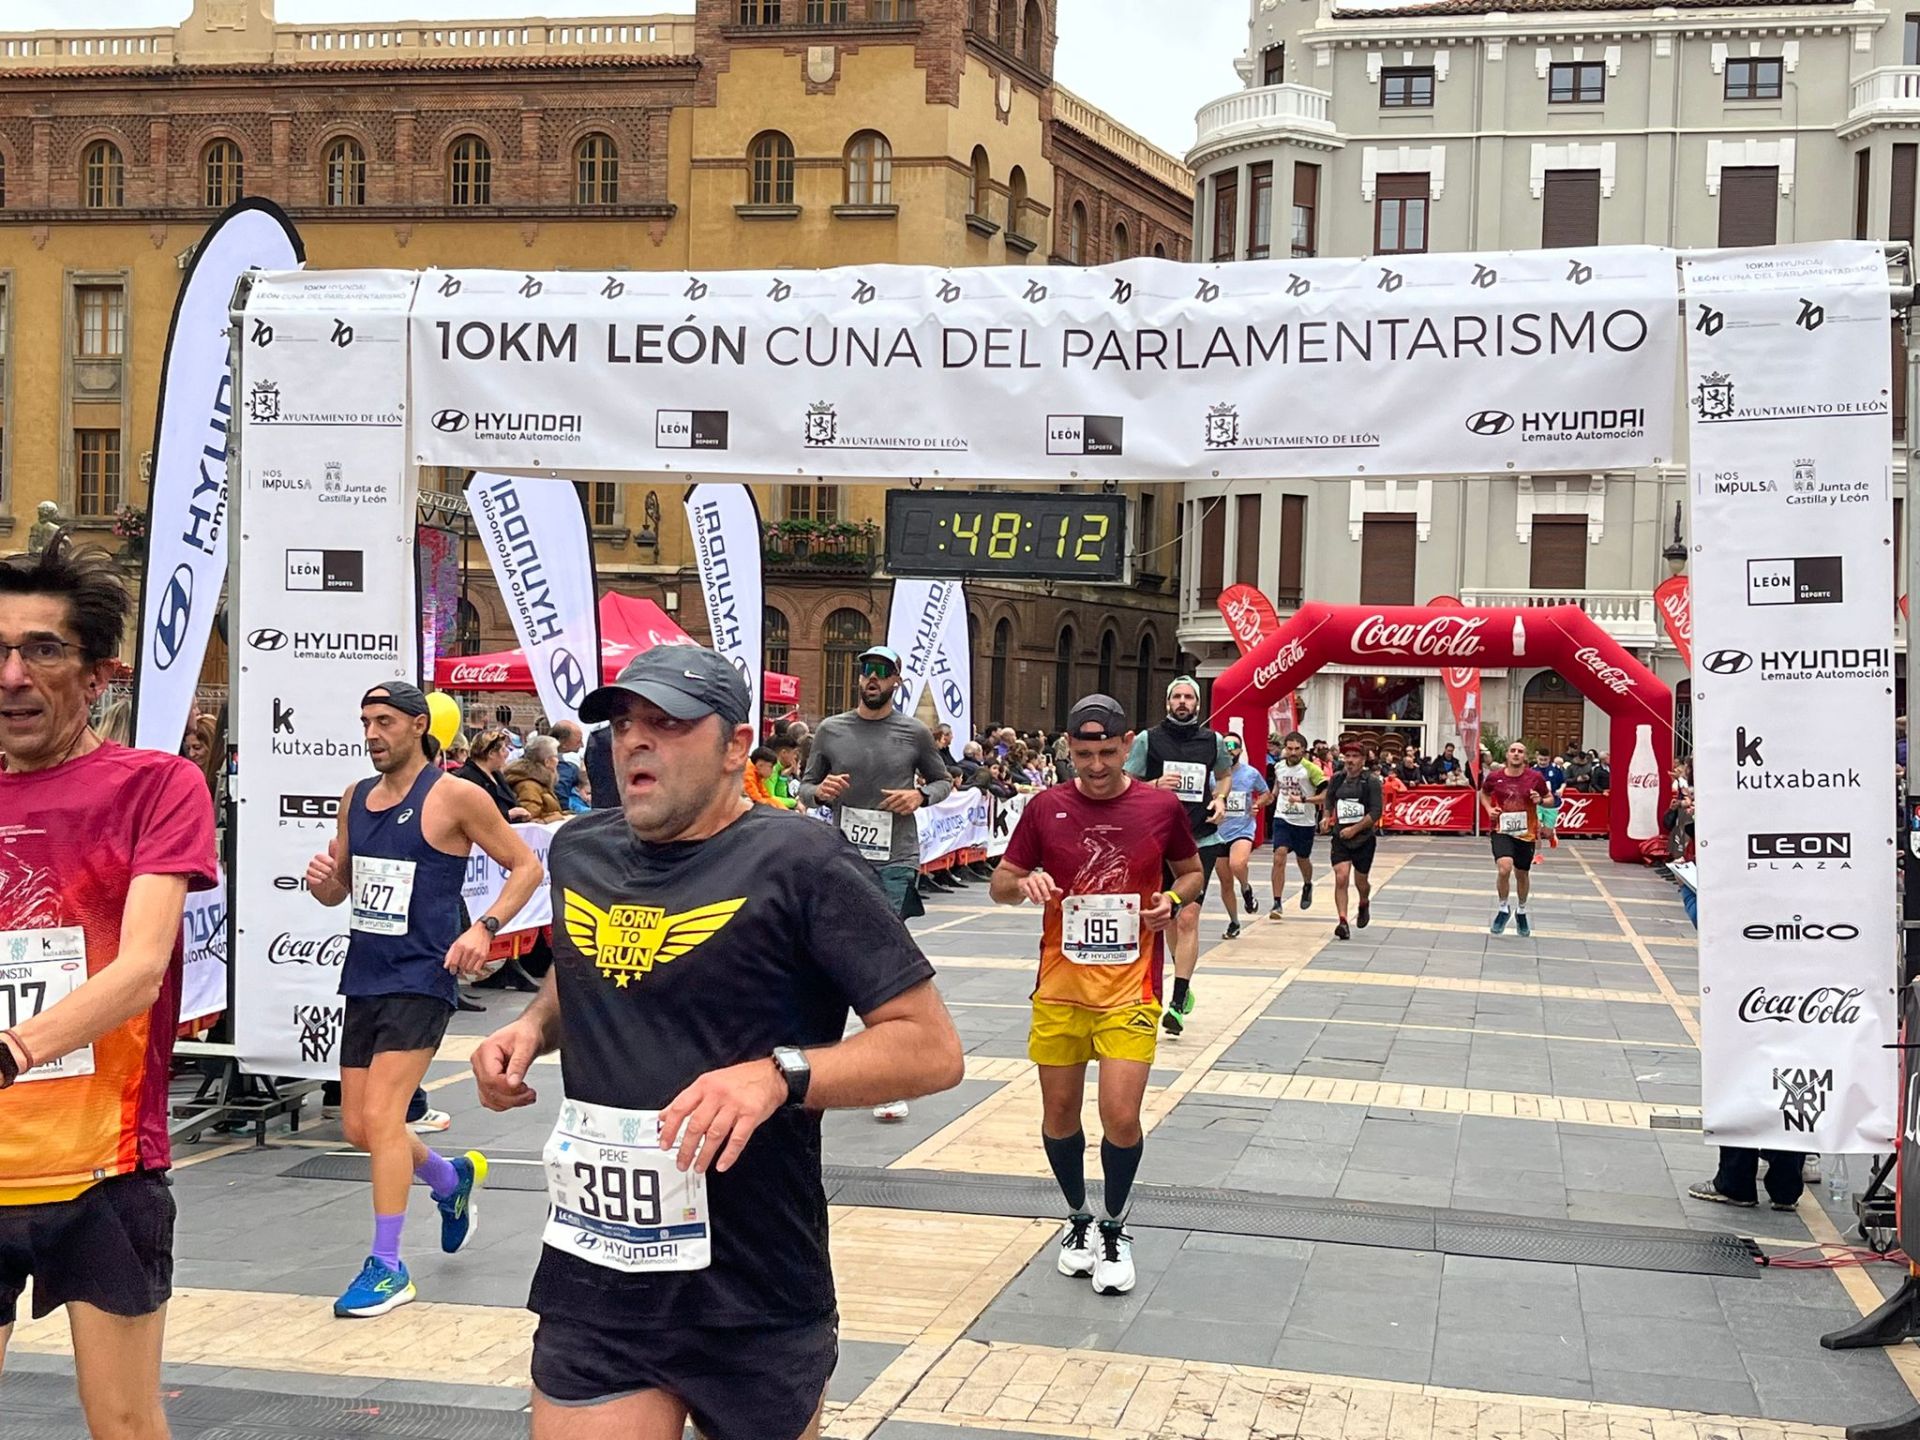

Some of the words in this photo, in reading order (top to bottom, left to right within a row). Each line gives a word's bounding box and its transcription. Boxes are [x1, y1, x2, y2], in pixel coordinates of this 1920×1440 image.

[436, 321, 578, 362] 10KM
[608, 313, 747, 366] LEÓN
[766, 326, 922, 369] CUNA
[943, 327, 1041, 369] DEL
[1063, 309, 1648, 370] PARLAMENTARISMO
[282, 413, 357, 422] AYUNTAMIENTO
[361, 413, 374, 422] DE
[377, 411, 402, 423] LEÓN
[1738, 404, 1833, 417] AYUNTAMIENTO
[1837, 403, 1852, 413] DE
[1856, 400, 1888, 412] LEÓN
[475, 412, 582, 433] HYUNDAI
[660, 421, 689, 435] LEÓN
[1523, 408, 1645, 433] HYUNDAI
[475, 432, 517, 441] Lemauto
[519, 432, 581, 442] Automoción
[839, 436, 921, 447] AYUNTAMIENTO
[924, 438, 939, 447] DE
[942, 436, 969, 448] LEÓN
[1051, 427, 1081, 441] LEÓN
[1241, 434, 1328, 447] AYUNTAMIENTO
[1331, 434, 1348, 445] DE
[1350, 432, 1381, 445] LEÓN
[1522, 431, 1573, 442] Lemauto
[1576, 428, 1644, 441] Automoción
[263, 469, 282, 478] NOS
[1715, 471, 1739, 481] NOS
[262, 479, 312, 491] IMPULSA
[344, 484, 372, 494] Junta
[374, 484, 387, 493] de
[1715, 480, 1777, 495] IMPULSA
[1818, 482, 1851, 492] Junta
[1854, 481, 1869, 491] de
[318, 493, 352, 503] Castilla
[353, 496, 360, 505] y
[362, 494, 387, 503] León
[1786, 494, 1827, 505] Castilla
[1829, 496, 1837, 506] y
[1840, 492, 1869, 503] León
[290, 561, 320, 575] LEÓN
[1753, 573, 1791, 588] LEÓN
[906, 581, 946, 673] HYUND
[1351, 614, 1489, 657] Coca-Cola
[294, 632, 398, 651] HYUNDAI
[294, 650, 337, 660] Lemauto
[339, 650, 398, 661] Automoción
[1253, 636, 1307, 690] Coca-Cola
[1761, 648, 1889, 670] HYUNDAI
[451, 662, 511, 683] Coca-Cola
[1574, 647, 1638, 696] Coca-Cola
[1761, 670, 1812, 681] Lemauto
[1815, 668, 1889, 679] Automoción
[1736, 768, 1861, 790] kutxabank
[851, 824, 878, 845] 522
[1751, 836, 1848, 855] LEON
[1747, 861, 1852, 871] PLAZA
[360, 882, 394, 911] 427
[611, 911, 660, 929] BORN
[1743, 914, 1859, 940] emico
[620, 930, 640, 944] TO
[1084, 918, 1118, 943] 195
[601, 946, 651, 967] RUN
[1738, 986, 1865, 1024] Coca-Cola
[293, 1004, 343, 1026] KAM
[302, 1043, 333, 1063] NY
[1773, 1067, 1833, 1092] KAM
[1783, 1110, 1825, 1133] NY
[599, 1149, 629, 1164] PEKE
[574, 1161, 662, 1226] 399
[604, 1240, 678, 1260] HYUNDAI
